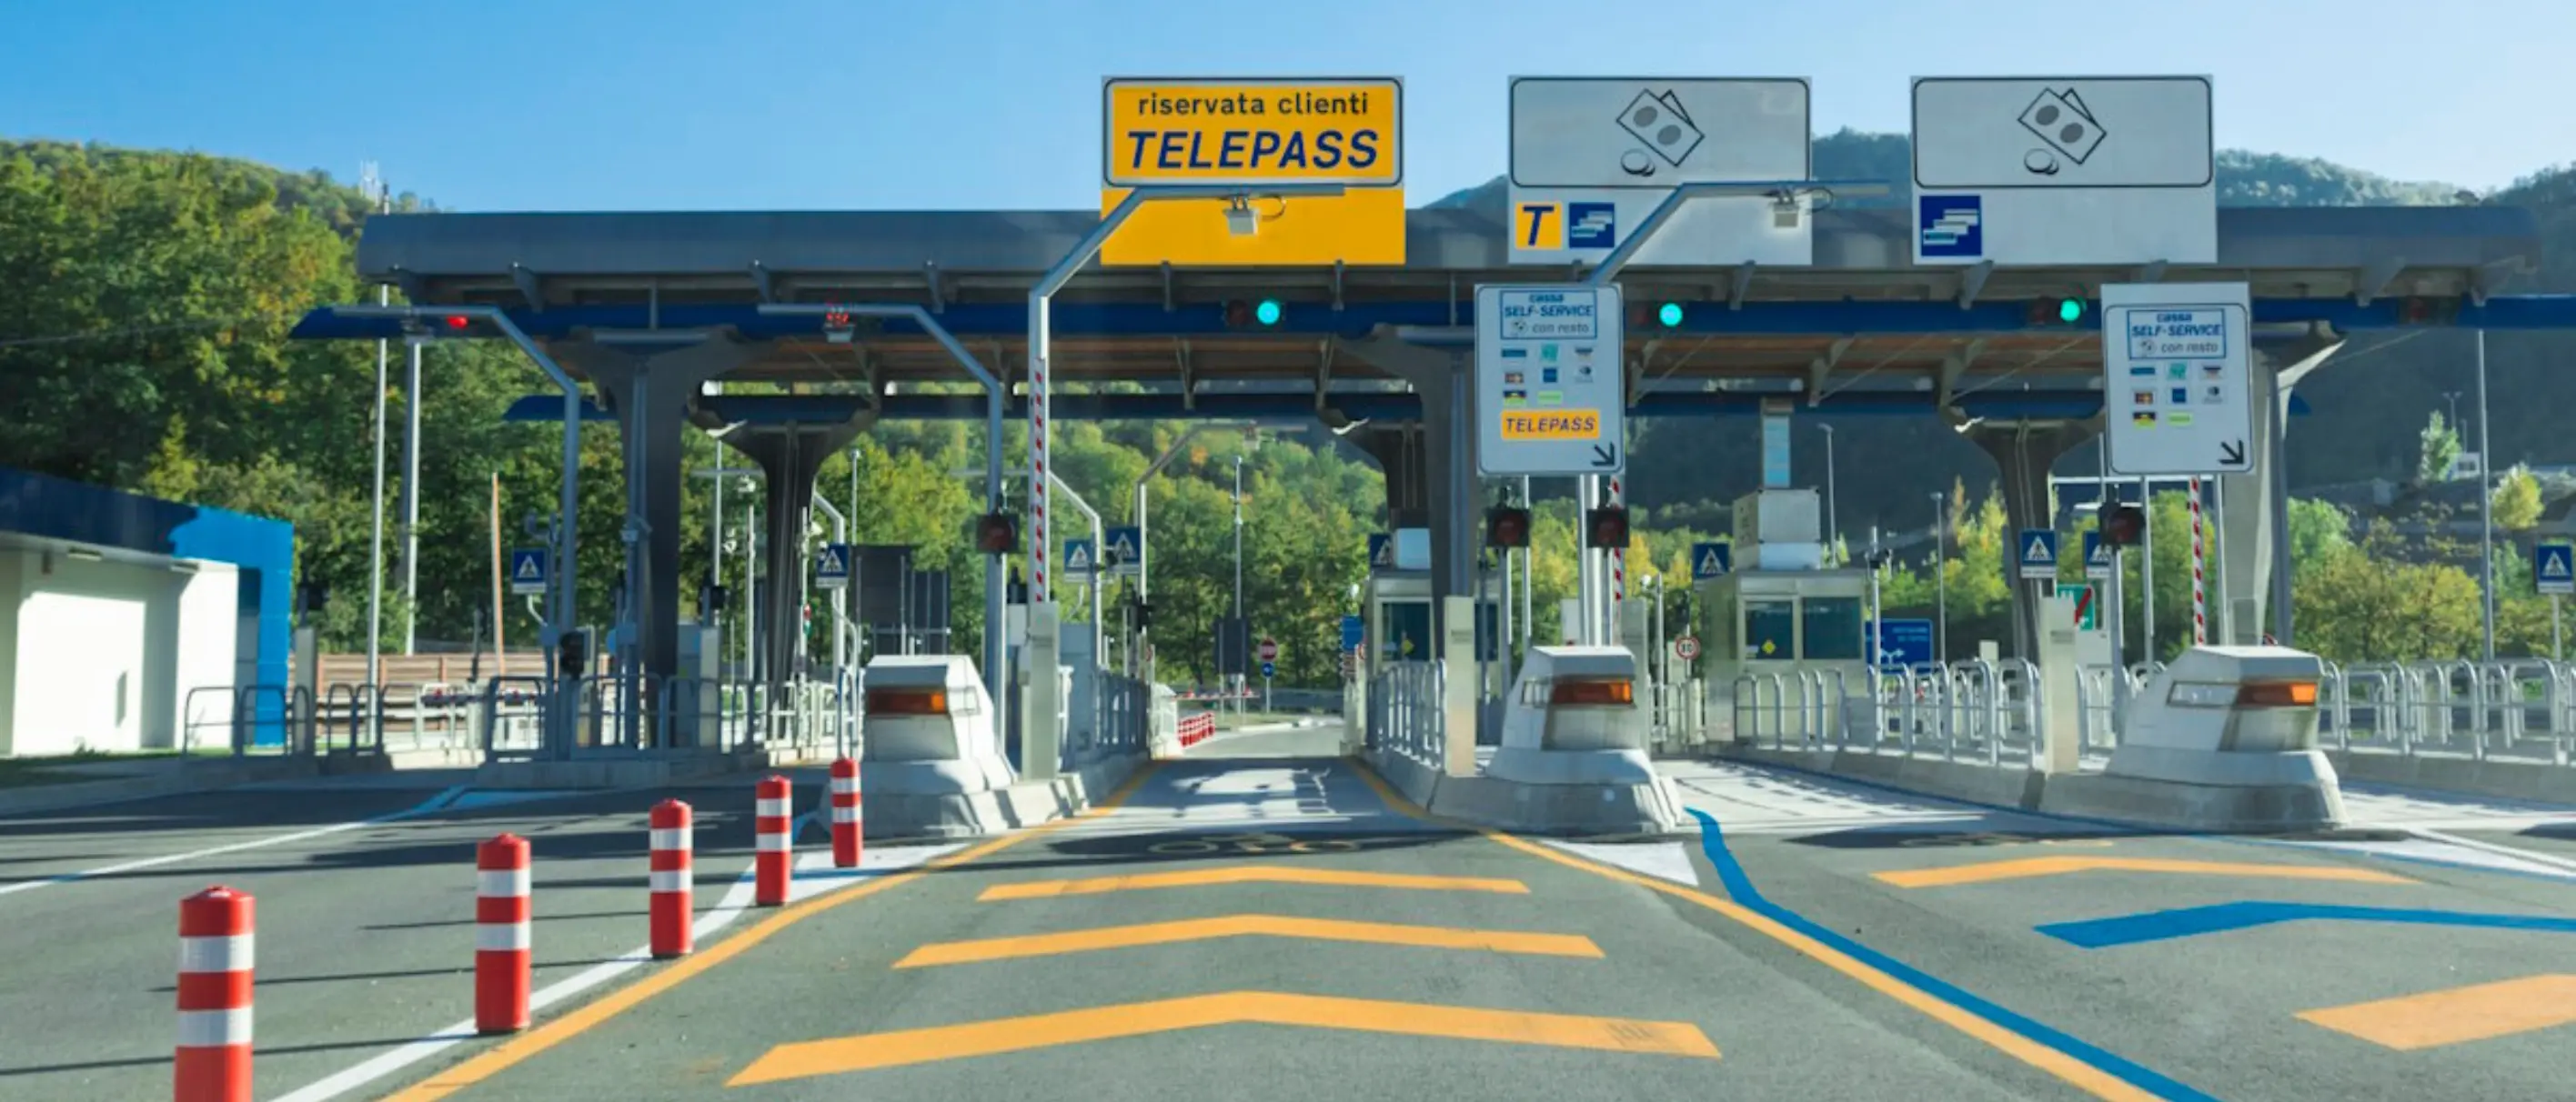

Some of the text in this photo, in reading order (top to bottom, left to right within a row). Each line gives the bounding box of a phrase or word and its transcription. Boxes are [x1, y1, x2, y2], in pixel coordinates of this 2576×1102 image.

[1139, 92, 1369, 115] riservata clienti
[1127, 129, 1380, 170] TELEPASS
[1522, 205, 1555, 247] T
[1529, 294, 1565, 304] cassa
[1504, 304, 1595, 318] SELF-SERVICE
[2156, 313, 2193, 323] cassa
[1532, 322, 1590, 334] con resto
[2131, 324, 2222, 337] SELF-SERVICE
[2161, 340, 2219, 354] con resto
[1505, 416, 1596, 434] TELEPASS
